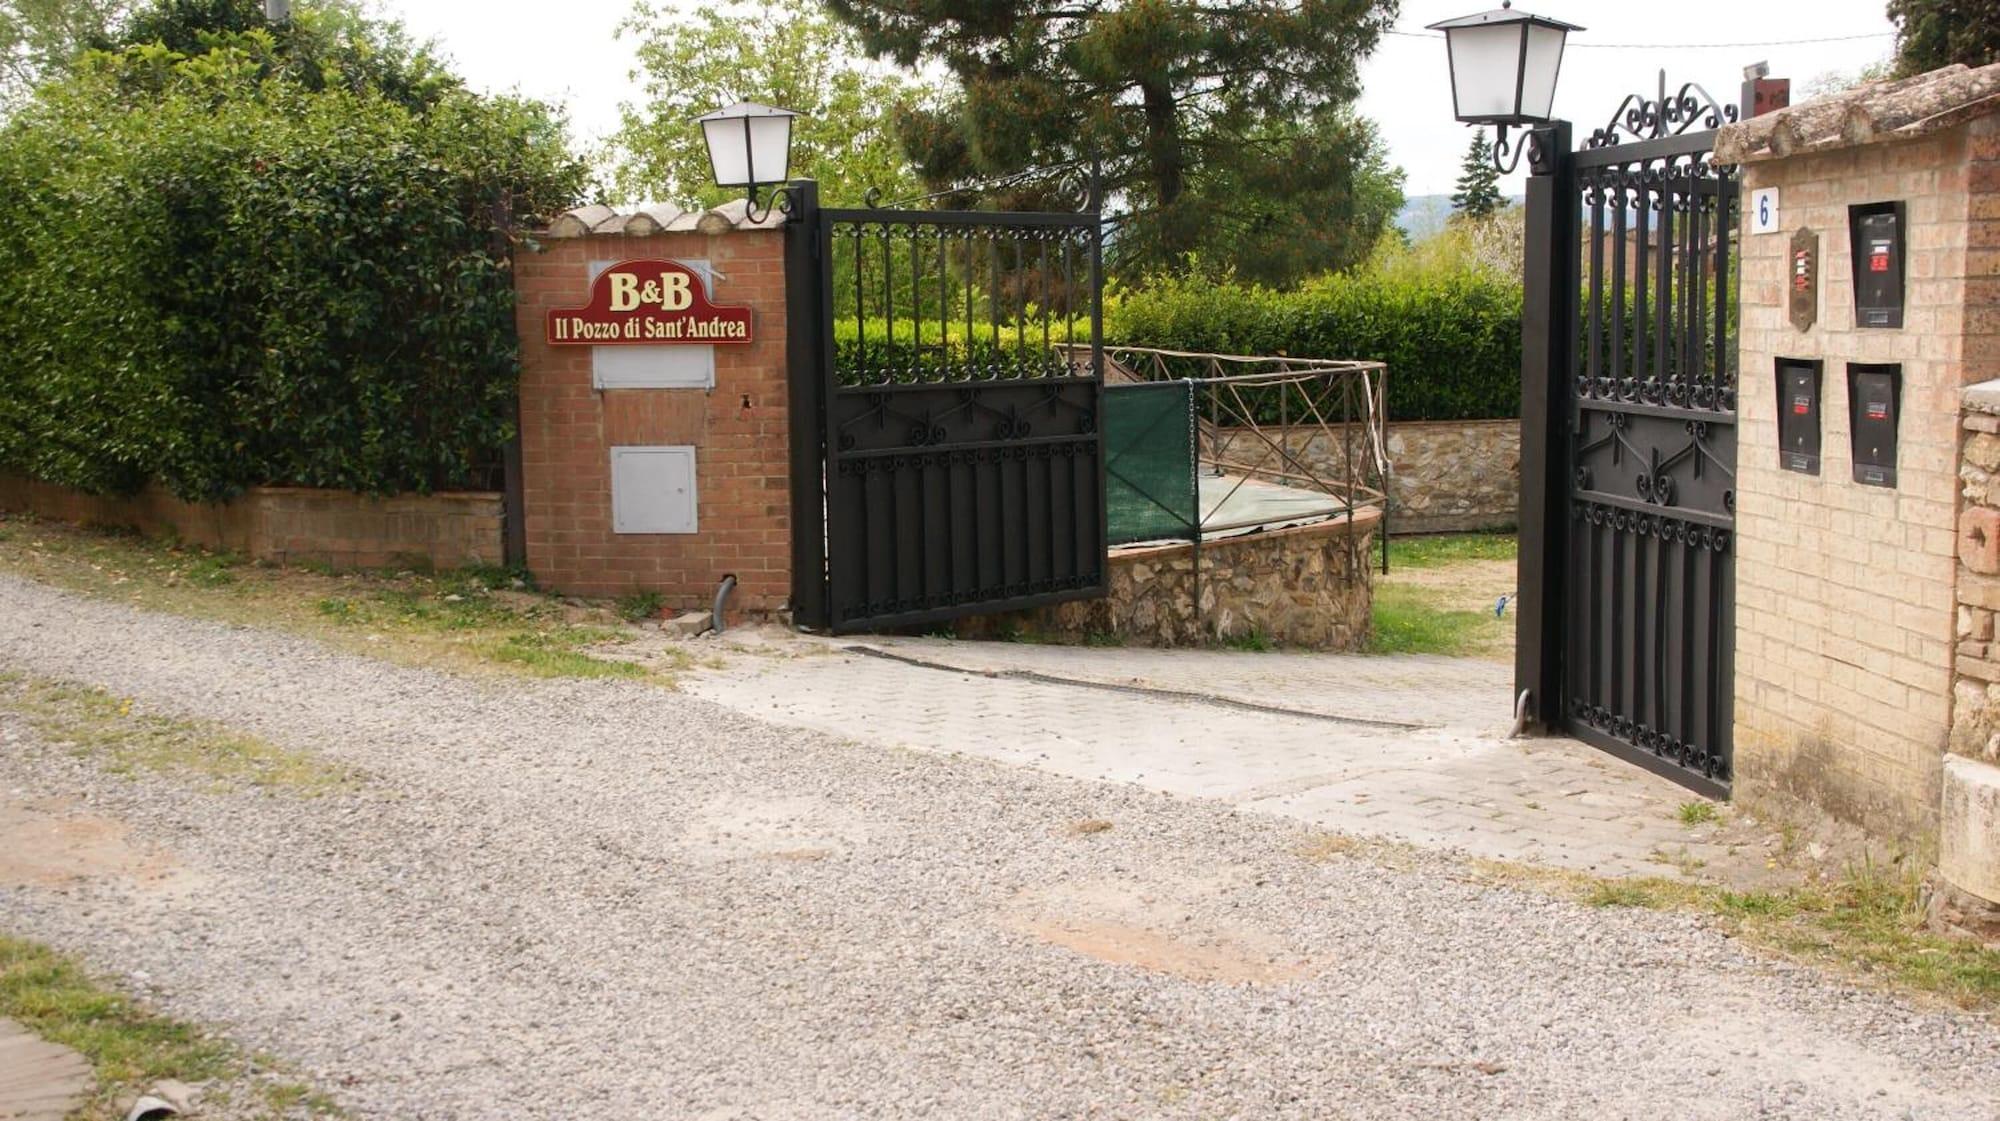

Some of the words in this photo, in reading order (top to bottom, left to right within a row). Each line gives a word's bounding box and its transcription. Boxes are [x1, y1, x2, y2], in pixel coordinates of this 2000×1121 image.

[1760, 194, 1769, 227] 6
[608, 271, 693, 312] B&B
[555, 318, 568, 339] Il
[572, 318, 620, 339] Pozzo
[624, 317, 640, 339] di
[644, 316, 746, 338] Sant'Andrea
